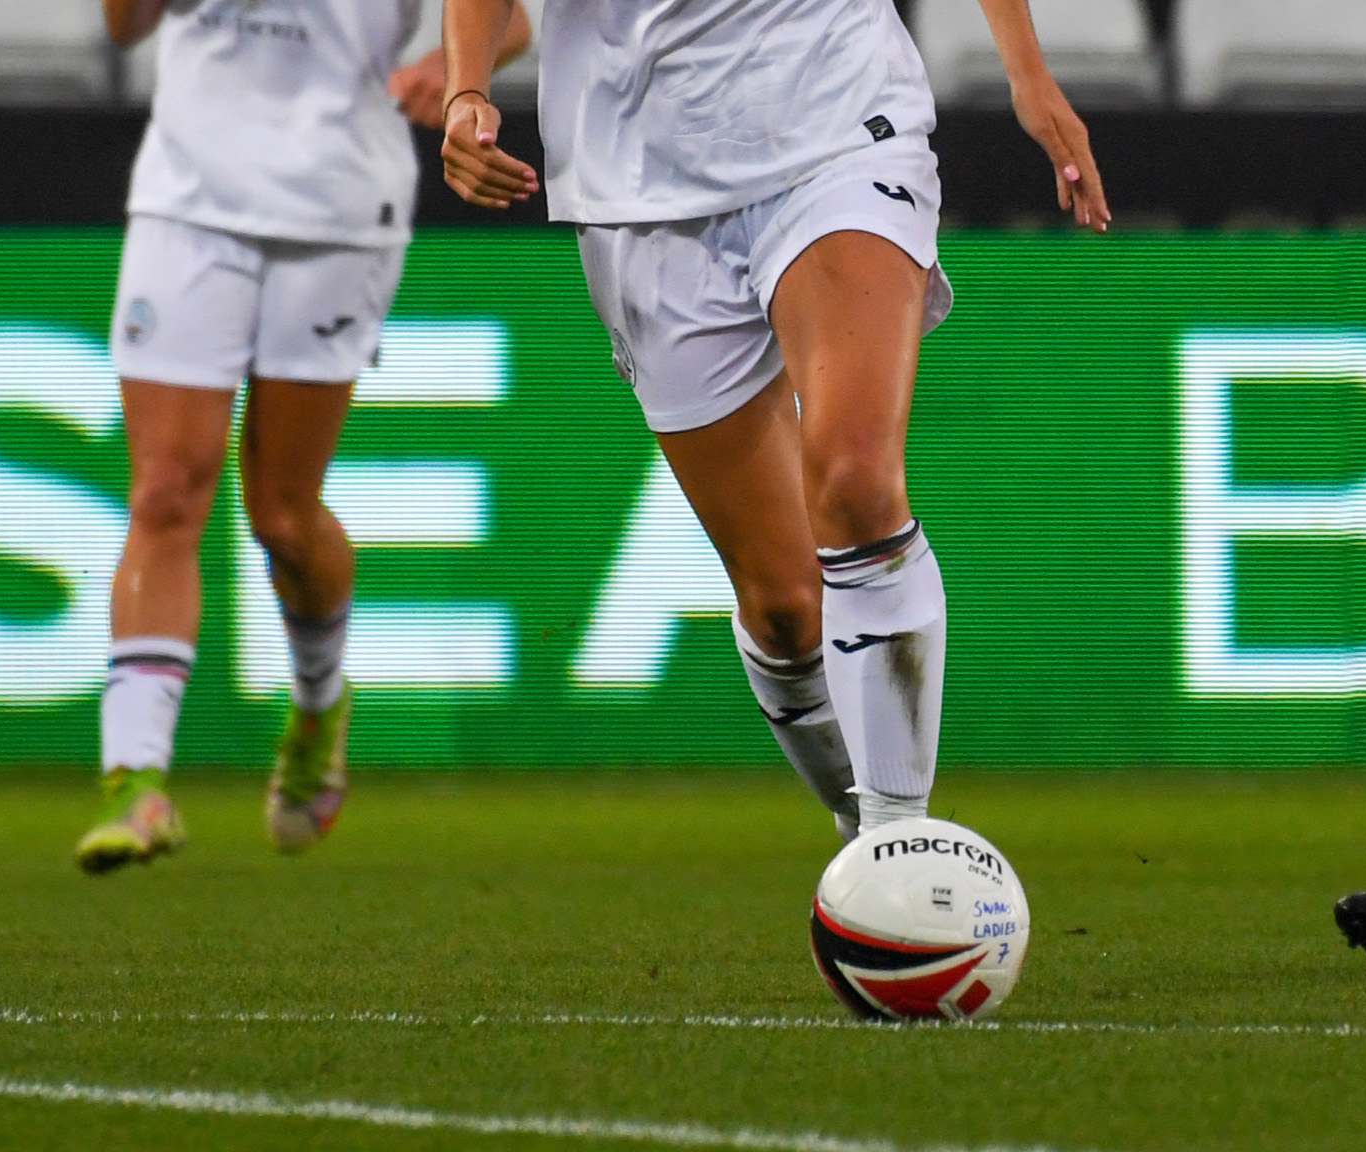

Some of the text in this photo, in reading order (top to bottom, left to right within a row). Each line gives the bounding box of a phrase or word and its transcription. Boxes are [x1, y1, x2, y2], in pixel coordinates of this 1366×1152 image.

[873, 837, 1003, 876] macron
[973, 921, 1017, 939] LADIES
[998, 943, 1010, 965] 7
